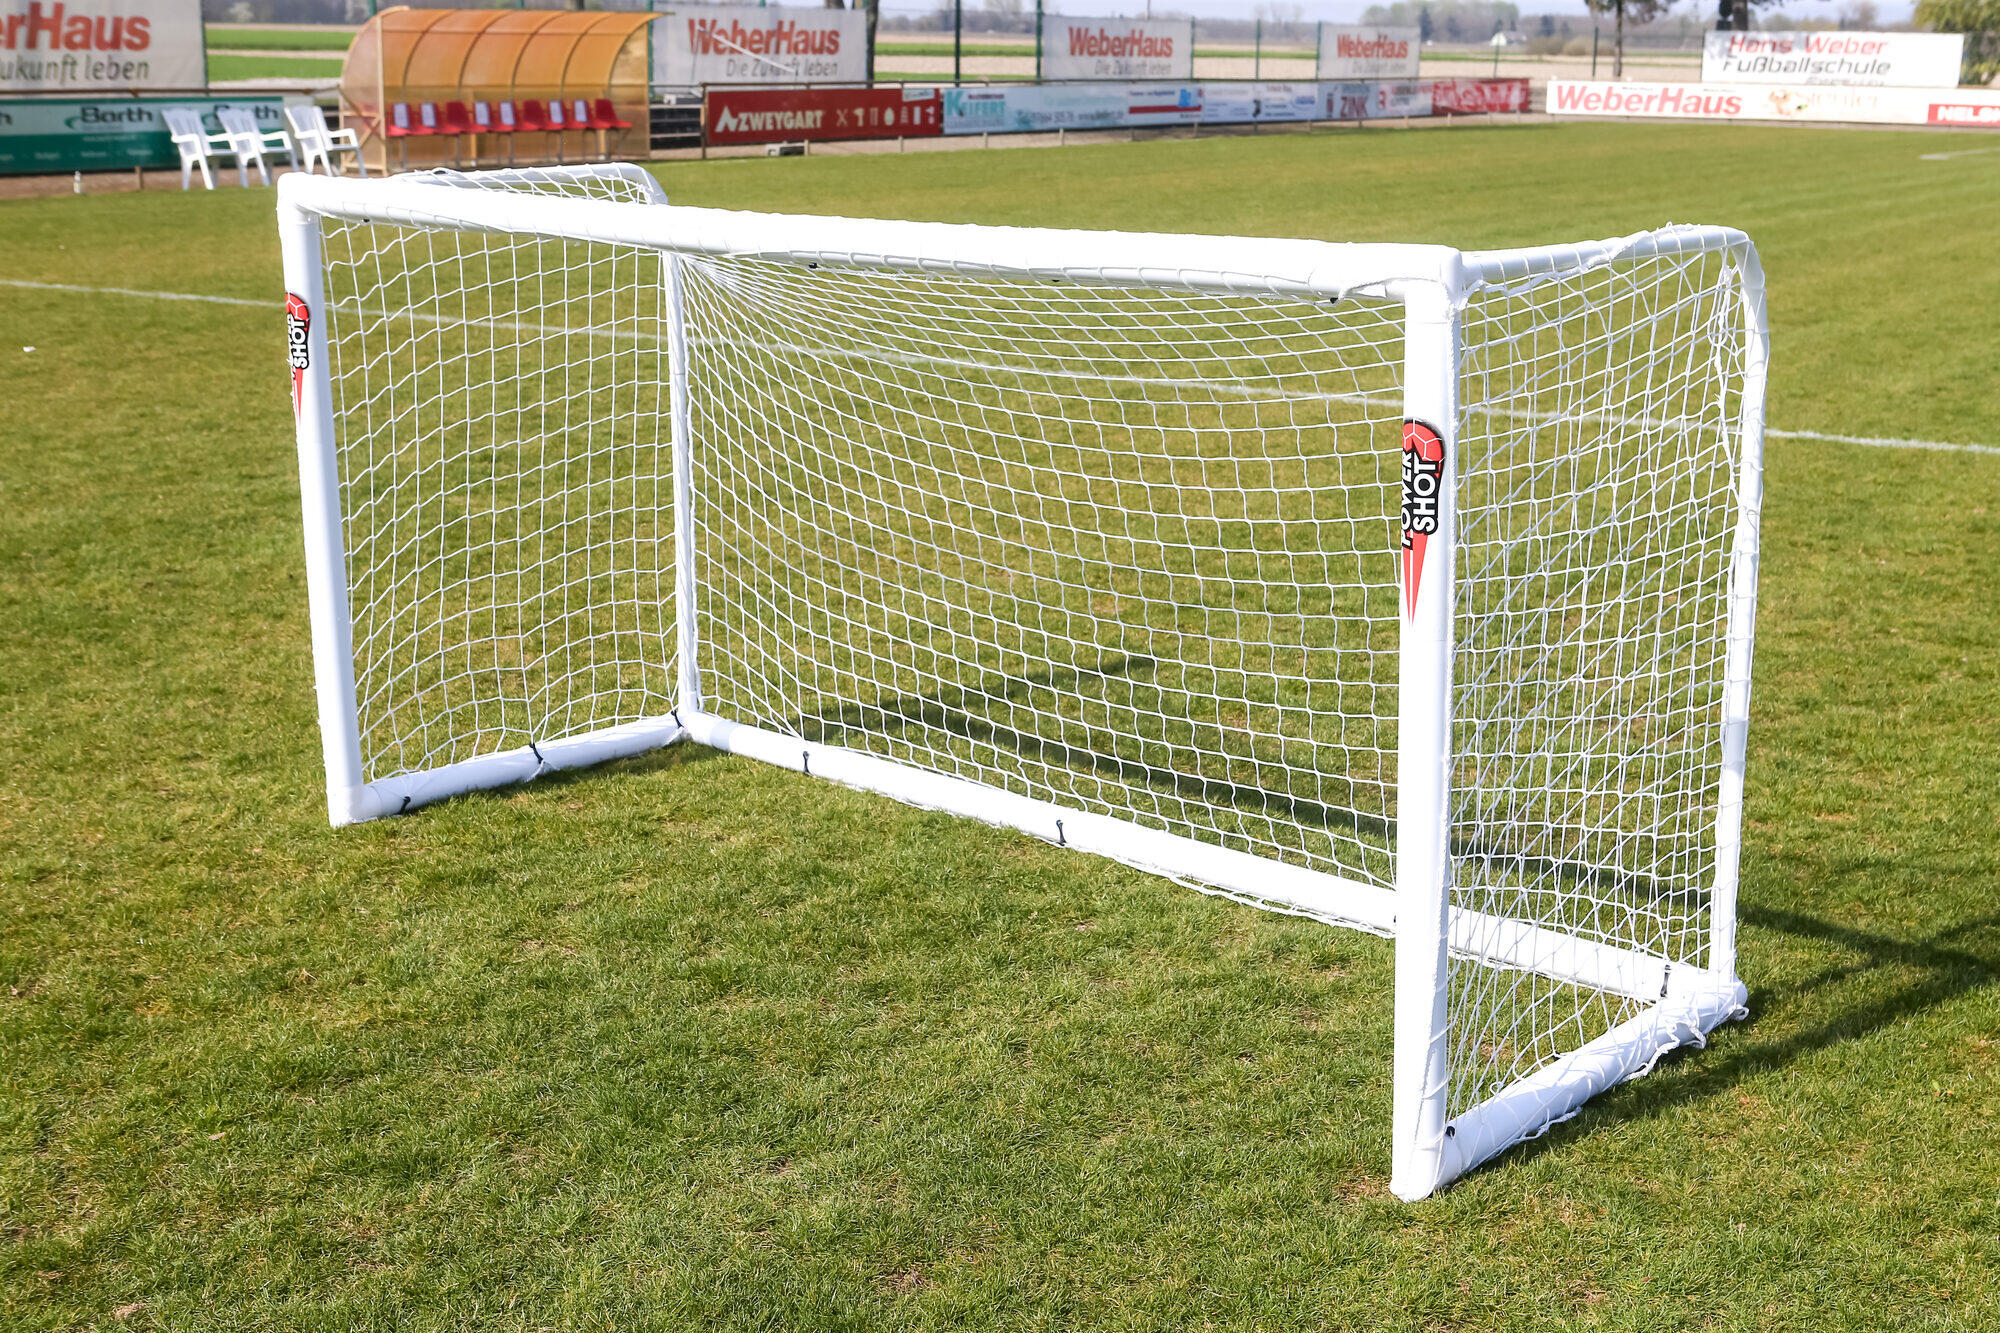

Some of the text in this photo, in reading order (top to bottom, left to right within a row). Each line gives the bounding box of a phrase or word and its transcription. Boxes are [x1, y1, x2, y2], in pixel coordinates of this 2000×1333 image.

[0, 2, 151, 50] rHaus
[688, 18, 840, 55] WeberHaus
[1068, 26, 1173, 58] WeberHaus
[1337, 34, 1408, 58] WeberHaus
[1728, 35, 1888, 55] Hans Weber
[84, 55, 149, 80] leben
[726, 58, 748, 77] Die
[803, 58, 838, 77] leben
[1723, 54, 1891, 75] Fußballschule
[1557, 85, 1742, 114] WeberHaus
[80, 106, 152, 123] Barth
[292, 318, 309, 370] SHOT
[1413, 452, 1437, 533] SHOT
